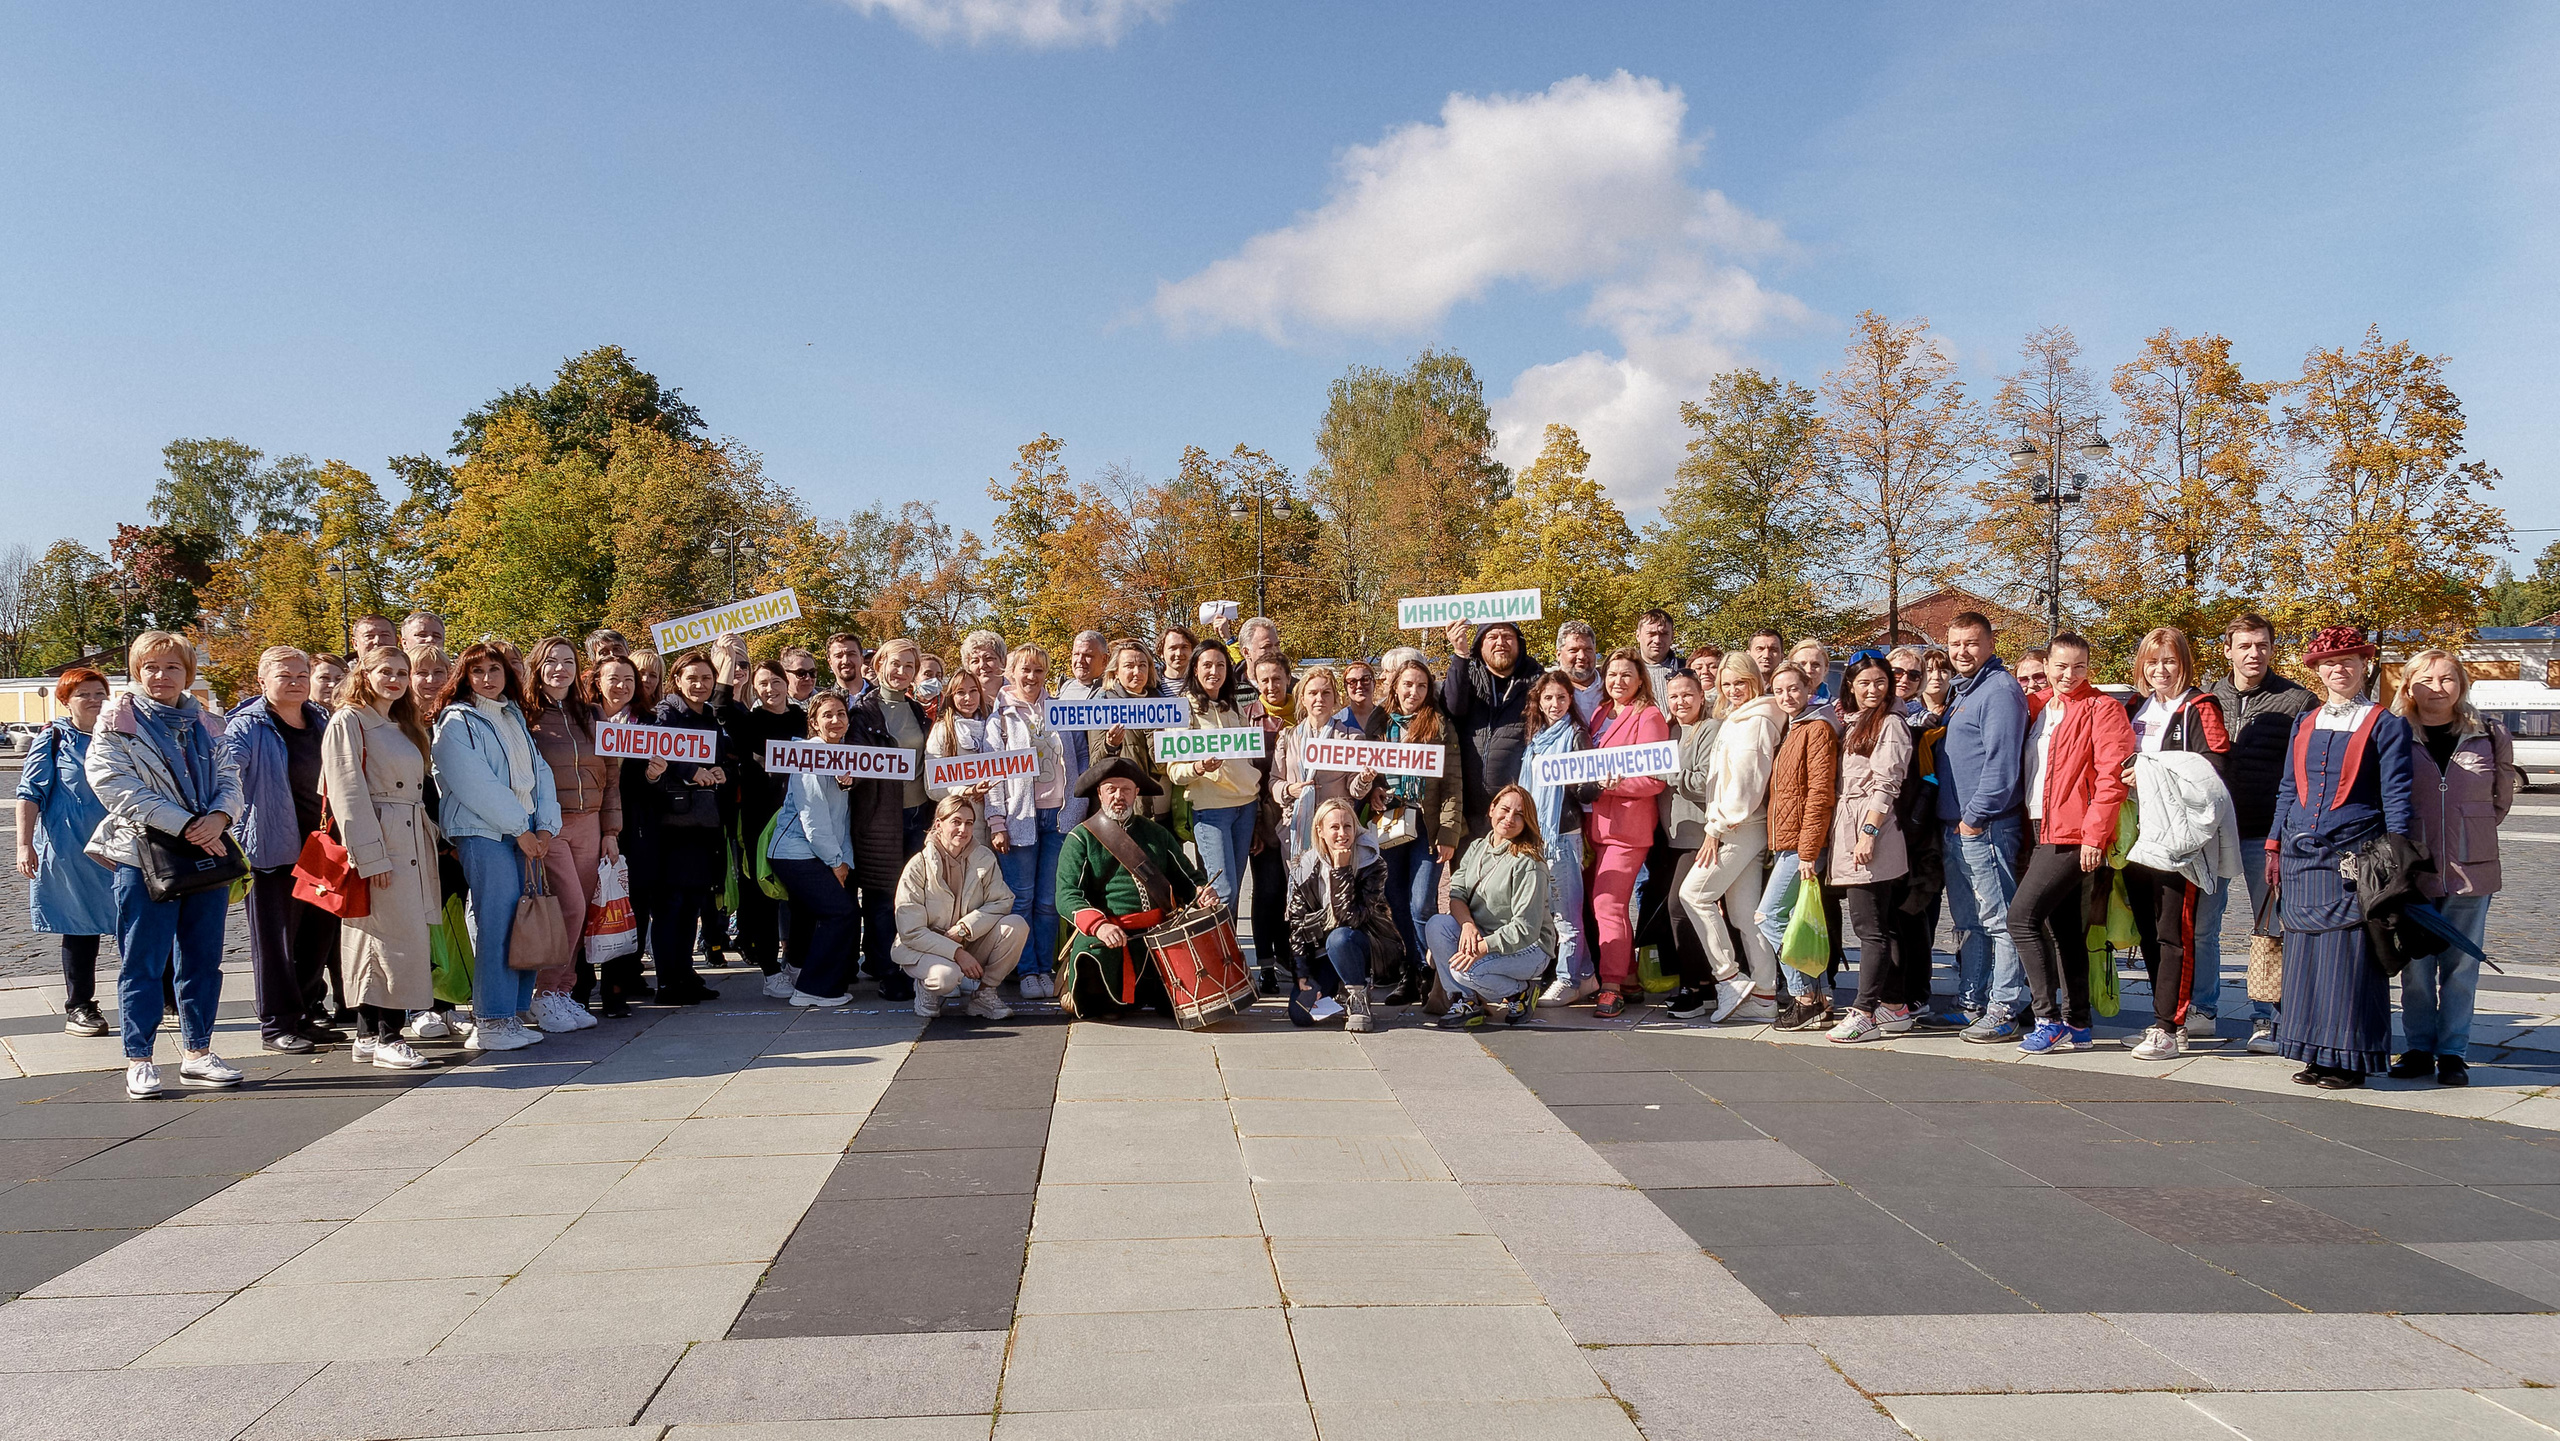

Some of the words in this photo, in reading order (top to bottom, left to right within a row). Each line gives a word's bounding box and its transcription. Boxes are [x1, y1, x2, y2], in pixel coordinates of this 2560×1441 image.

[660, 595, 794, 652] ДОСТИЖЕНИЯ
[1404, 595, 1535, 624] ИННОВАЦИИ
[1049, 703, 1183, 726] ОТВЕТСТВЕННОСТЬ
[601, 727, 711, 759] СМЕЛОСТЬ
[1160, 732, 1262, 760] ДОВЕРИЕ
[1306, 743, 1437, 771] ОПЕРЕЖЕНИЕ
[771, 746, 910, 774] НАДЕЖНОСТЬ
[933, 754, 1036, 784] АМБИЦИИ
[1541, 746, 1673, 783] СОТРУДНИЧЕСТВО
